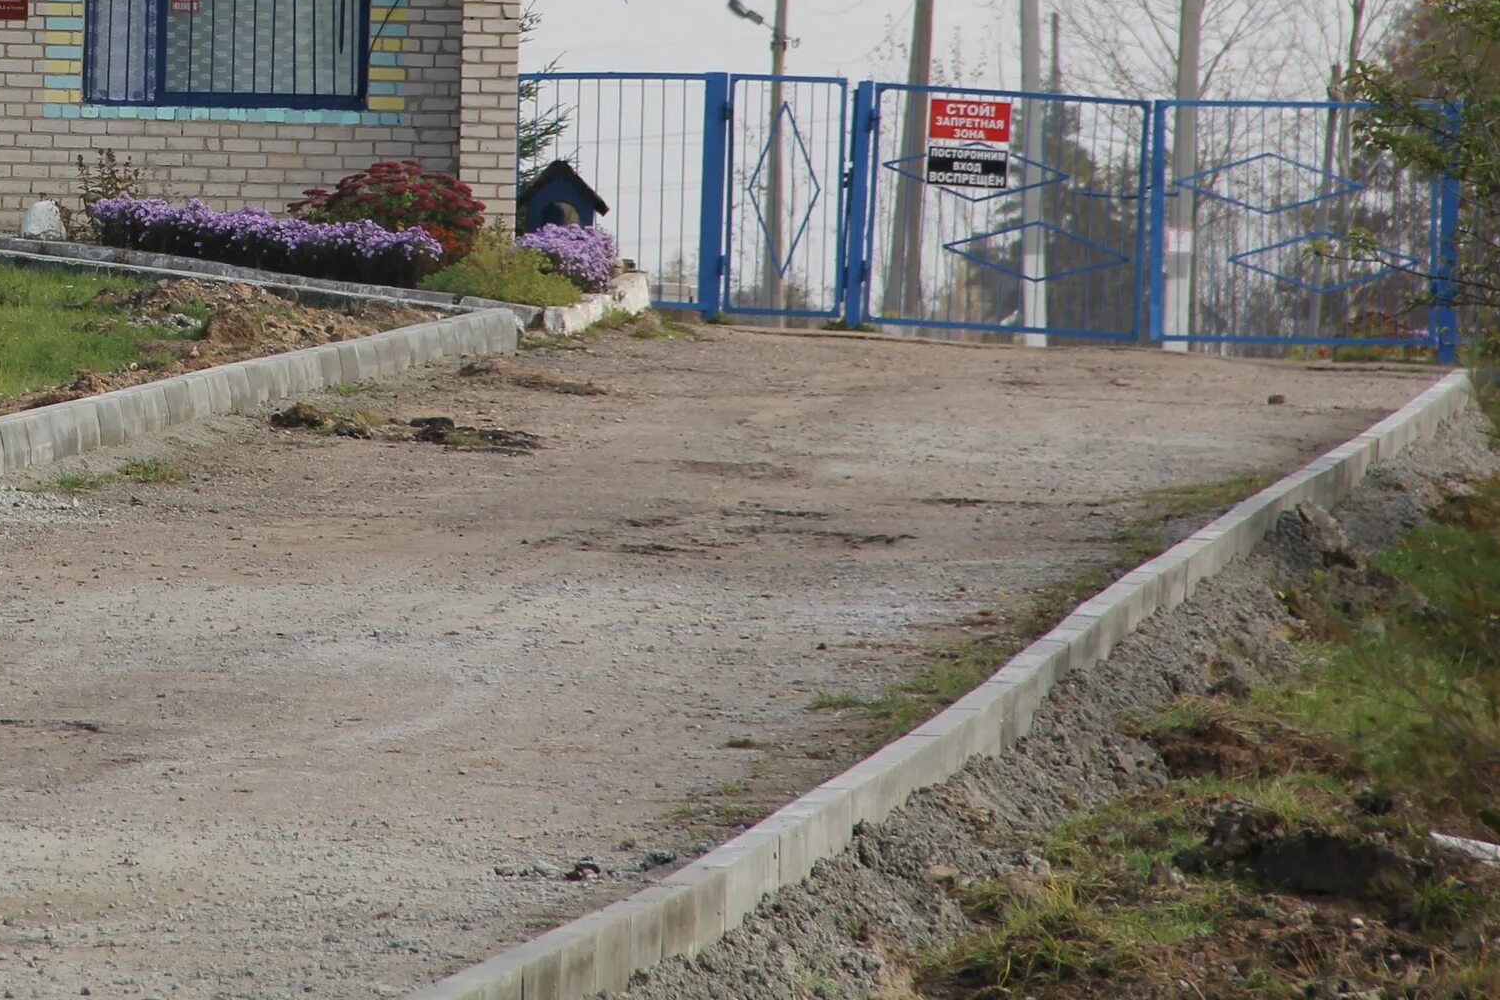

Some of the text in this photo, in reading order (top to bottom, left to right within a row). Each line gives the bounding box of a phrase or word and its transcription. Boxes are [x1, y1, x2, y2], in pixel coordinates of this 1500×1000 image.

[946, 103, 996, 117] СТОЙ!
[935, 116, 1004, 129] ЗАПРЕТНАЯ
[953, 128, 985, 139] ЗОНА
[931, 148, 1006, 161] ПОСТОРОННИМ
[953, 161, 982, 173] ВХОД
